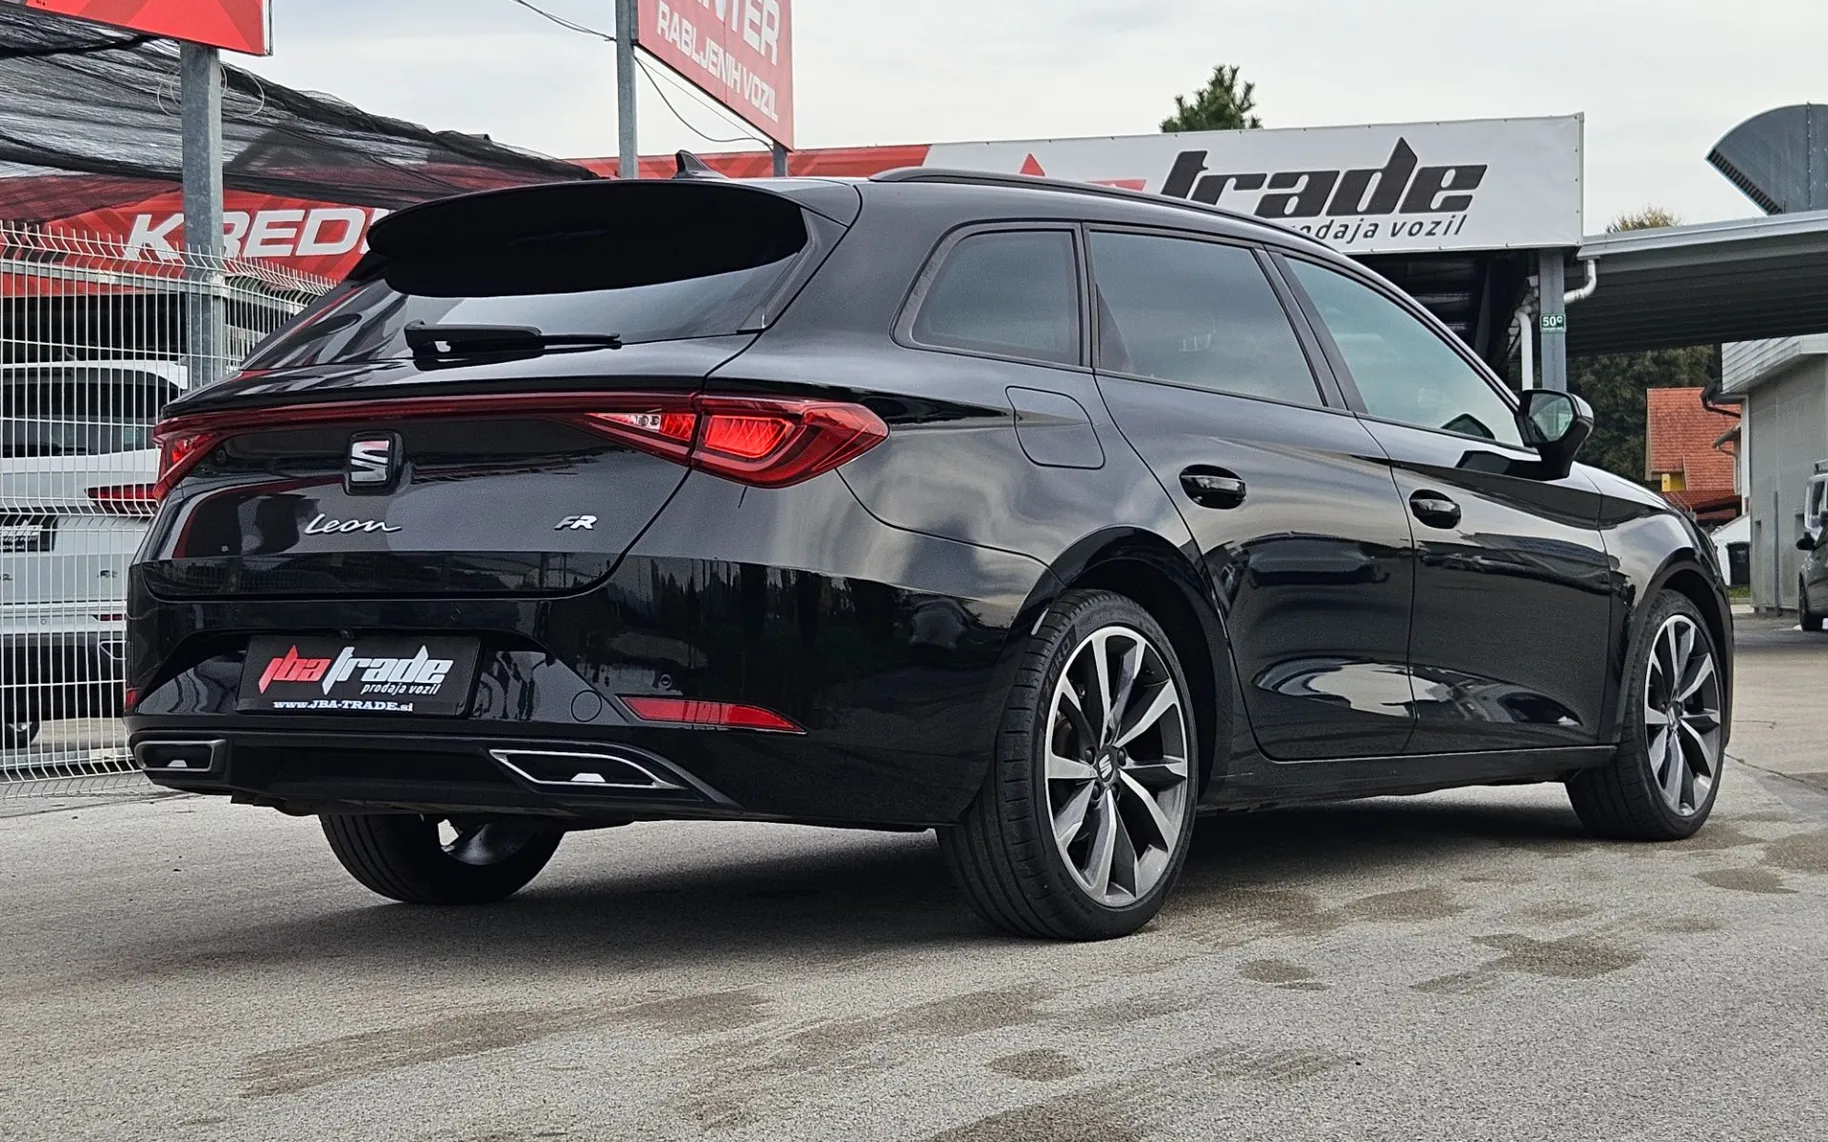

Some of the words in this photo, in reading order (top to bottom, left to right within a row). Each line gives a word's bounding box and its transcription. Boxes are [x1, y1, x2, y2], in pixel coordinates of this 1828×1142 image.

[657, 0, 741, 94] RABLJENIH
[742, 66, 780, 124] VOZIL
[1390, 214, 1468, 238] vozil
[303, 513, 401, 535] Leon
[553, 514, 597, 530] FR
[360, 682, 407, 696] prodaja
[408, 683, 442, 695] vozil
[273, 699, 414, 712] www.JBA-TRADE.si
